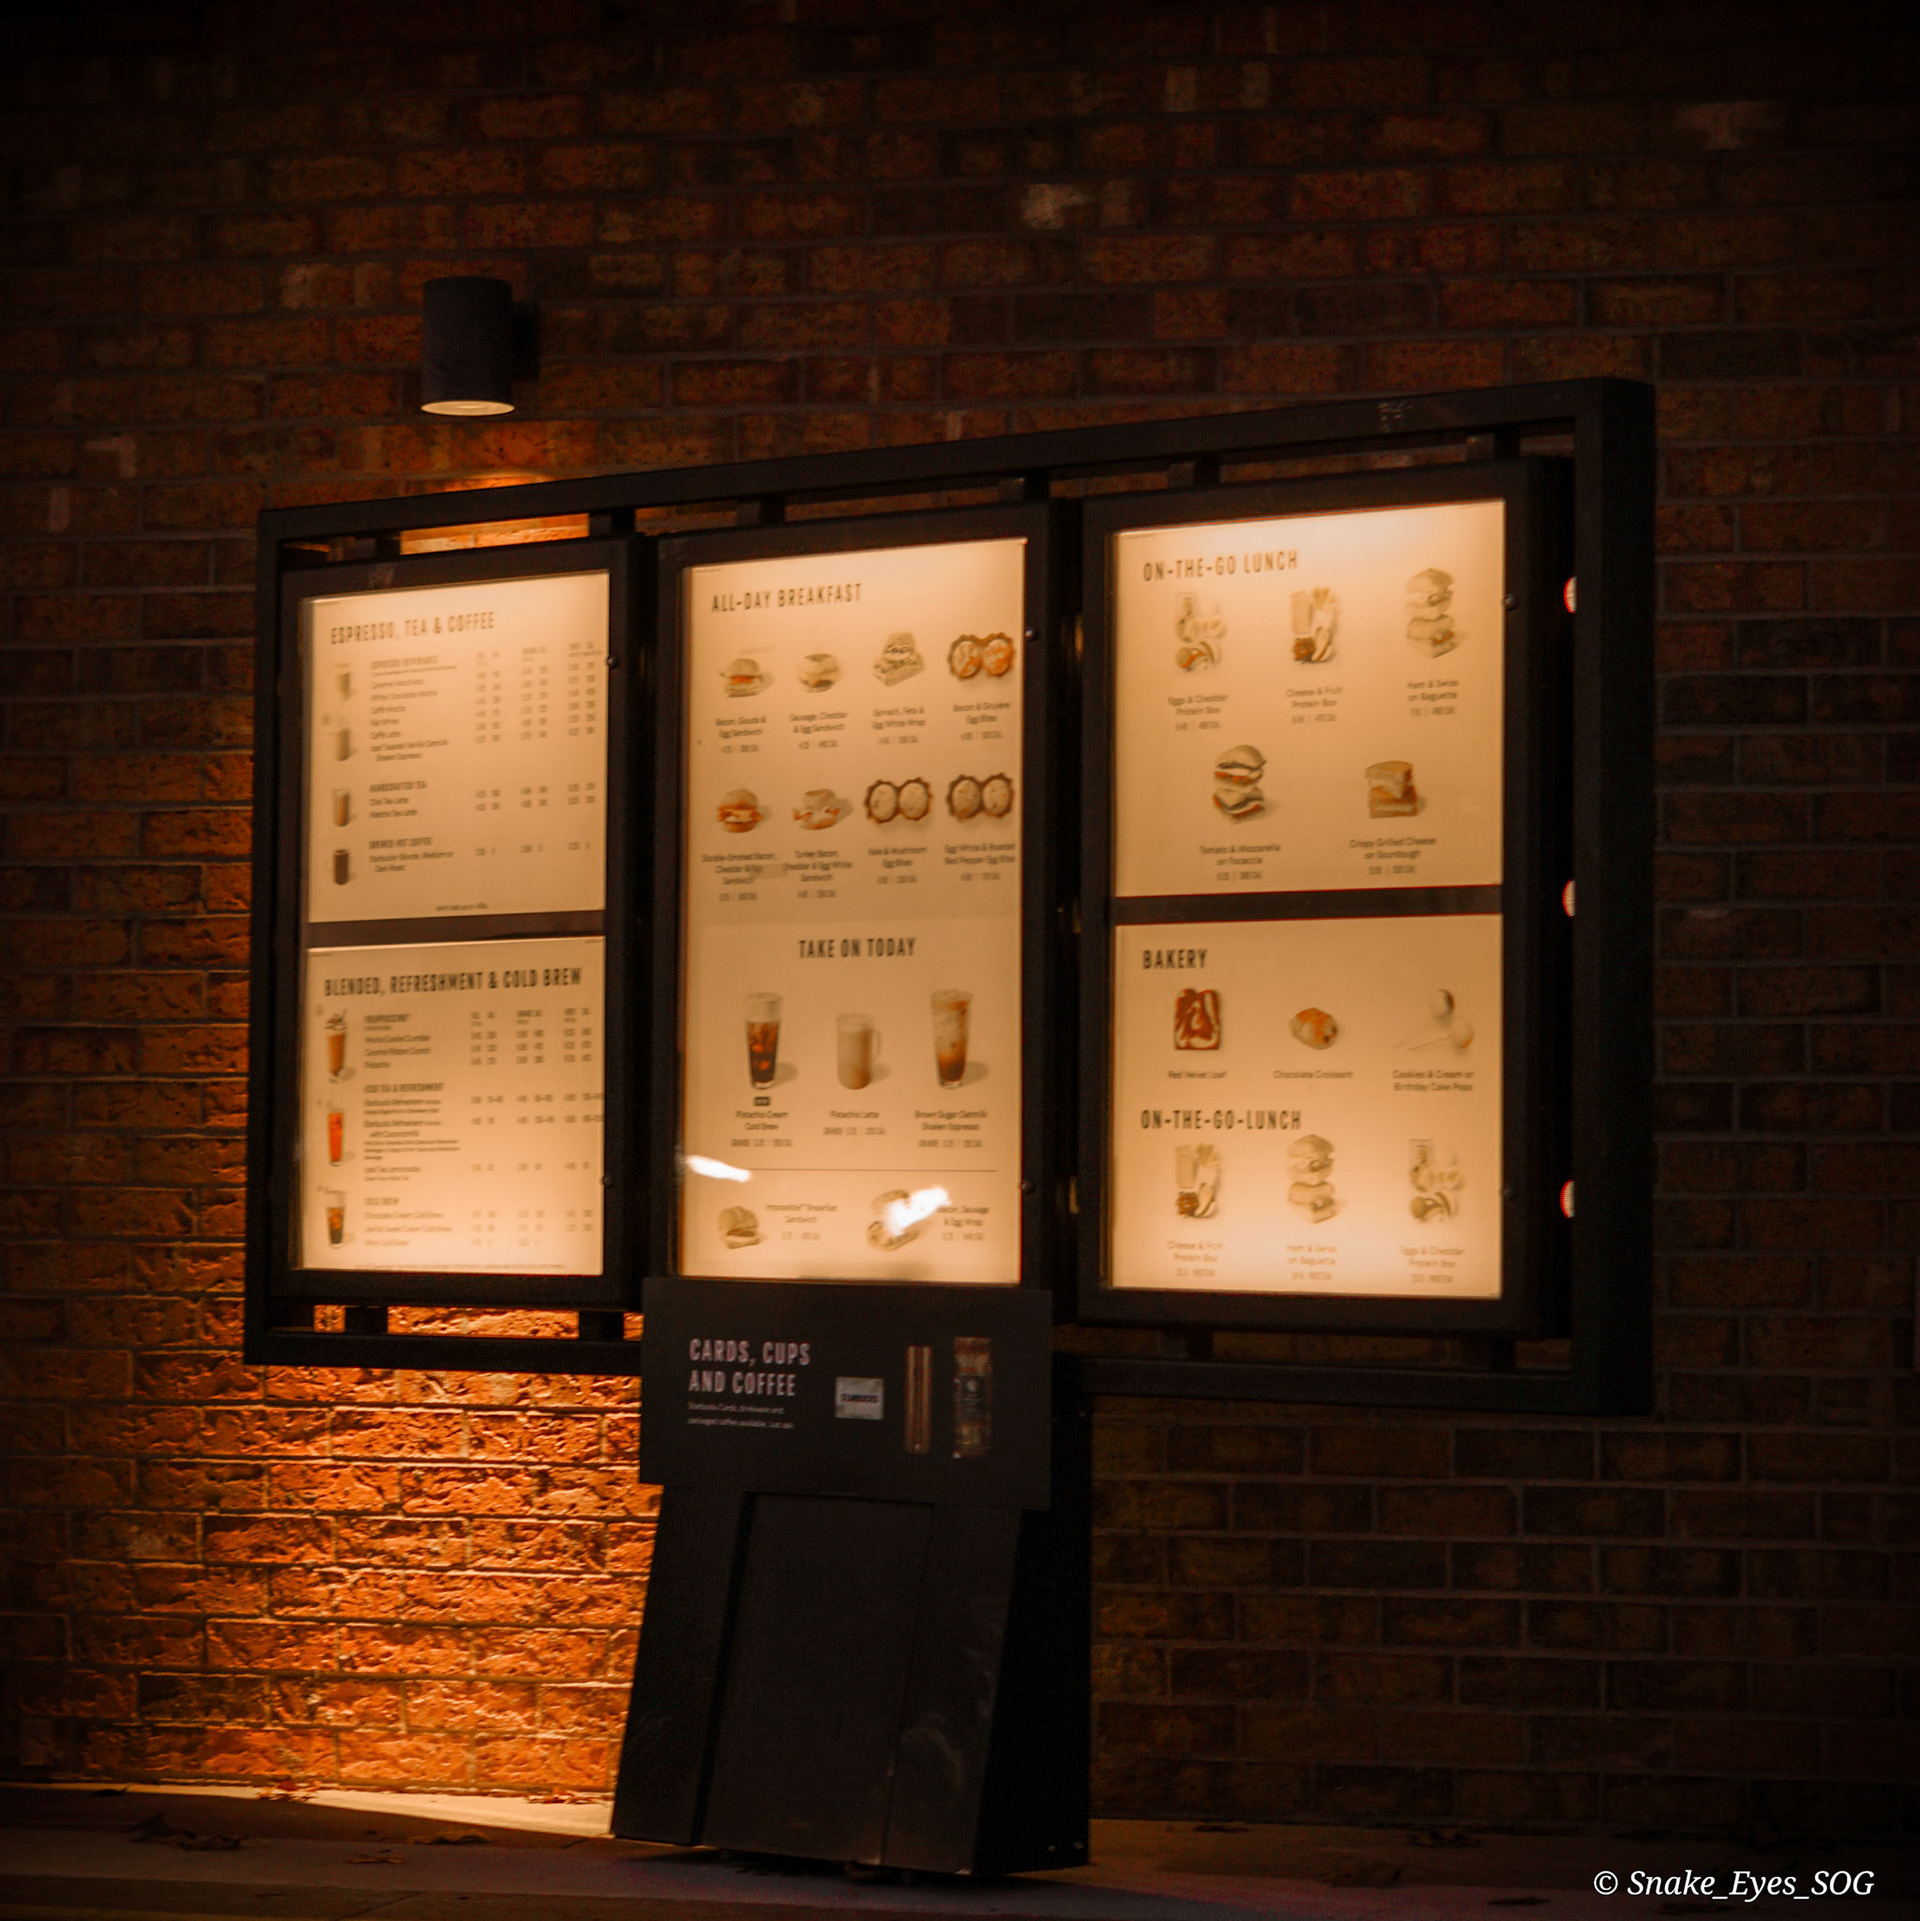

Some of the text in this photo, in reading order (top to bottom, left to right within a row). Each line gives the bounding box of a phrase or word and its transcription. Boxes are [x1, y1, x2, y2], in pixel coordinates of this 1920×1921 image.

[1143, 549, 1299, 582] ON-THE-GO LUNCH
[711, 583, 862, 613] ALL-DAY BREAKFAST
[405, 619, 427, 637] TEA
[433, 617, 441, 634] &
[448, 611, 495, 632] COFFEE
[798, 937, 916, 958] TAKE ON TODAY
[1142, 949, 1208, 970] BAKERY
[324, 967, 583, 997] BLENDED, REFRESHMENT & COLD BREW
[1141, 1110, 1302, 1130] ON-THE-GO-LUNCH
[688, 1338, 811, 1367] CARDS, CUPS
[688, 1370, 796, 1397] AND COFFEE
